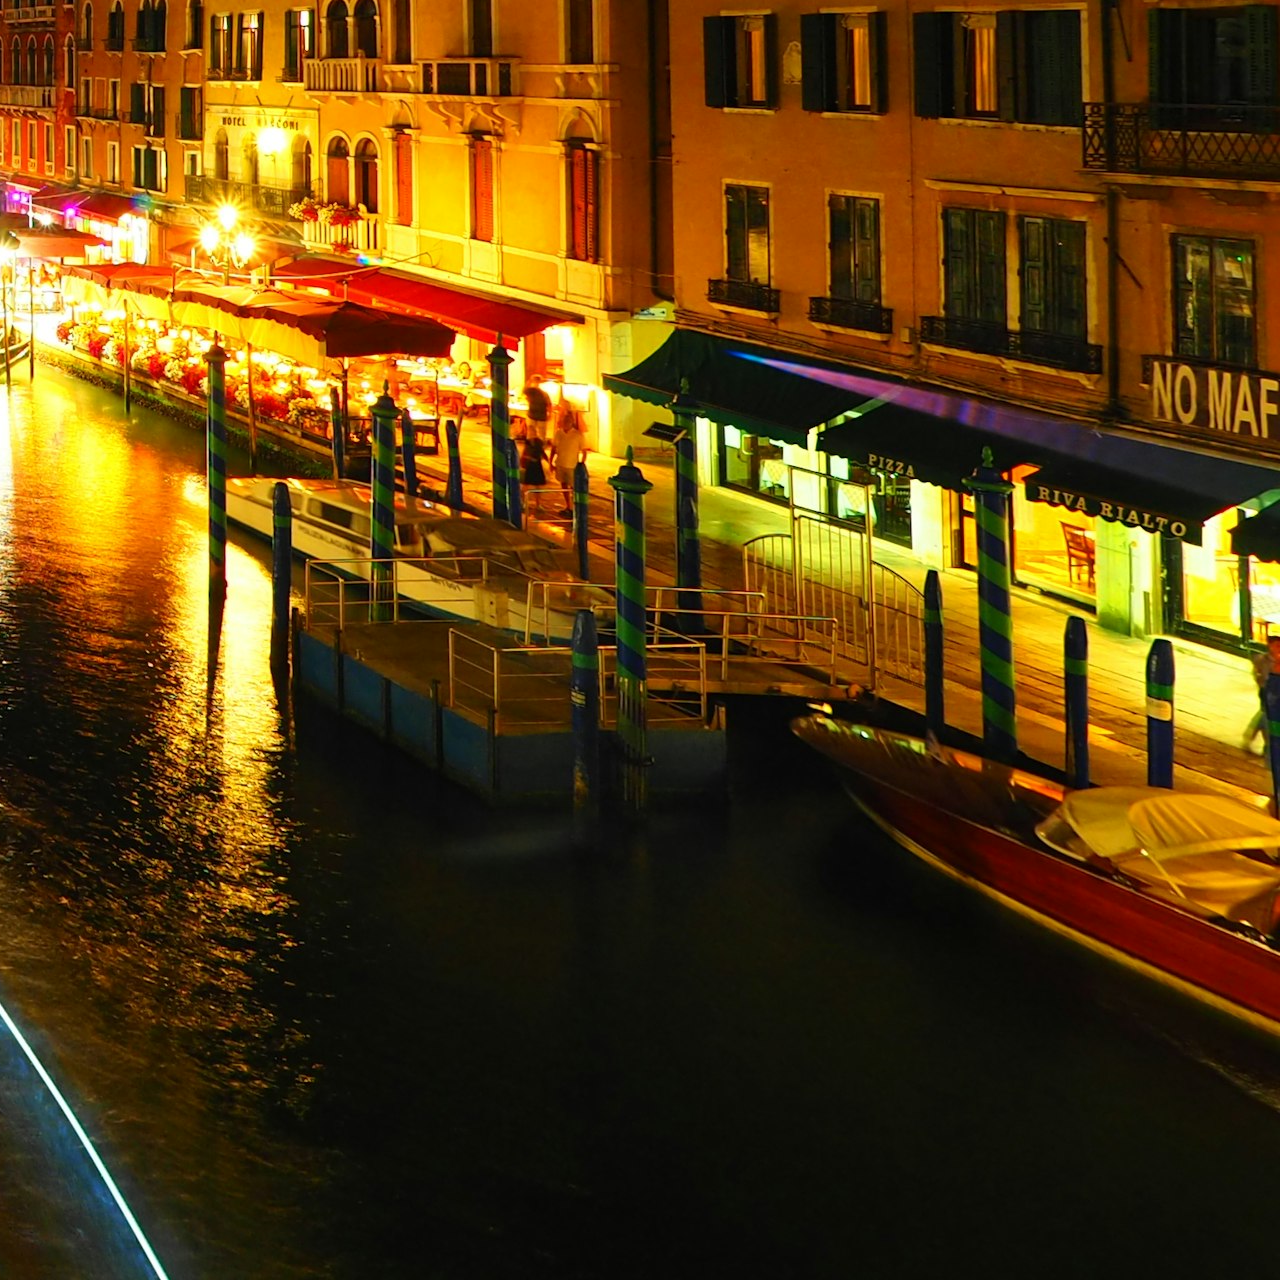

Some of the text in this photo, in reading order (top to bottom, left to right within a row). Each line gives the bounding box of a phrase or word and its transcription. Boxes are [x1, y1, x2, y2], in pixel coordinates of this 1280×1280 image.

[222, 116, 246, 126] HOTEL
[1153, 361, 1279, 439] NO MAF
[868, 453, 915, 478] PIZZA
[1038, 486, 1187, 537] RIVA RIALTO
